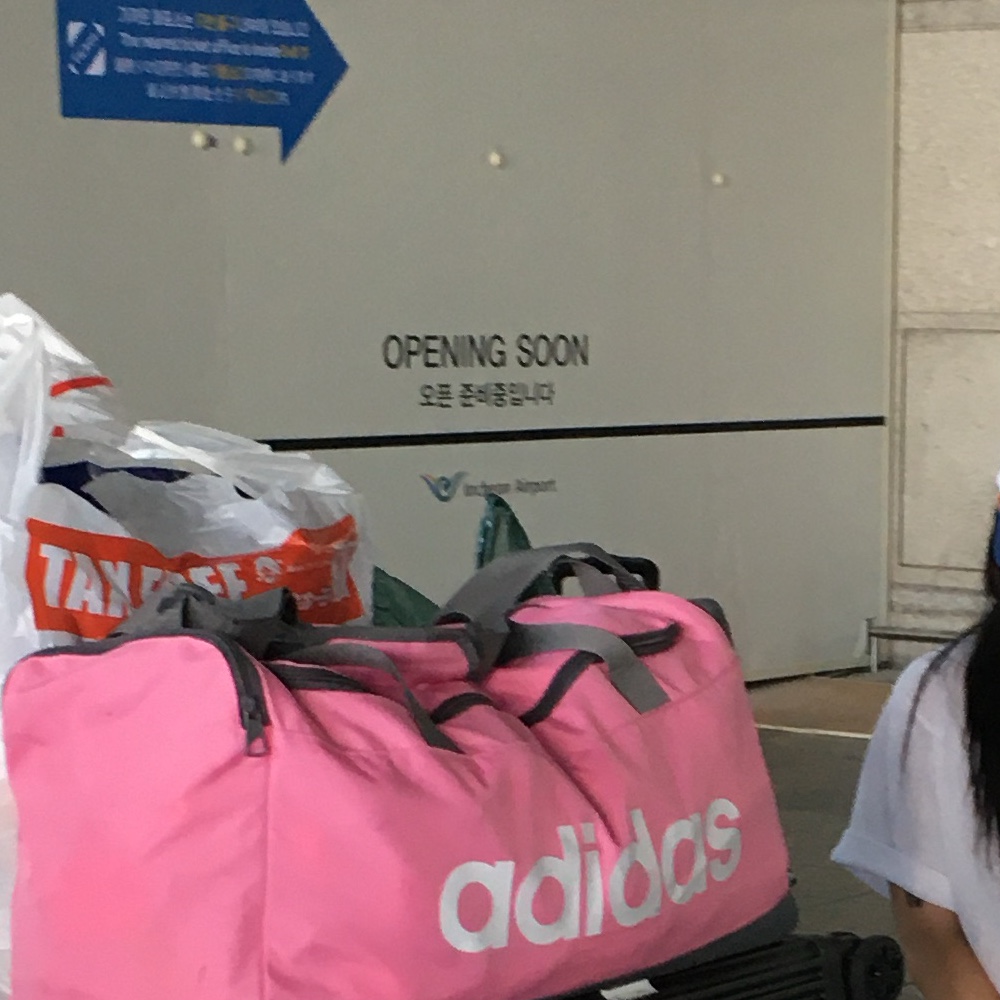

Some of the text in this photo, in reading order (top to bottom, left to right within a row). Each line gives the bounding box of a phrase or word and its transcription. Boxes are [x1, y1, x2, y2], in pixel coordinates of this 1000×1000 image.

[383, 334, 589, 369] OPENING SOON
[419, 383, 453, 409] 오픈
[39, 543, 131, 618] TAX
[439, 798, 742, 953] adidas
